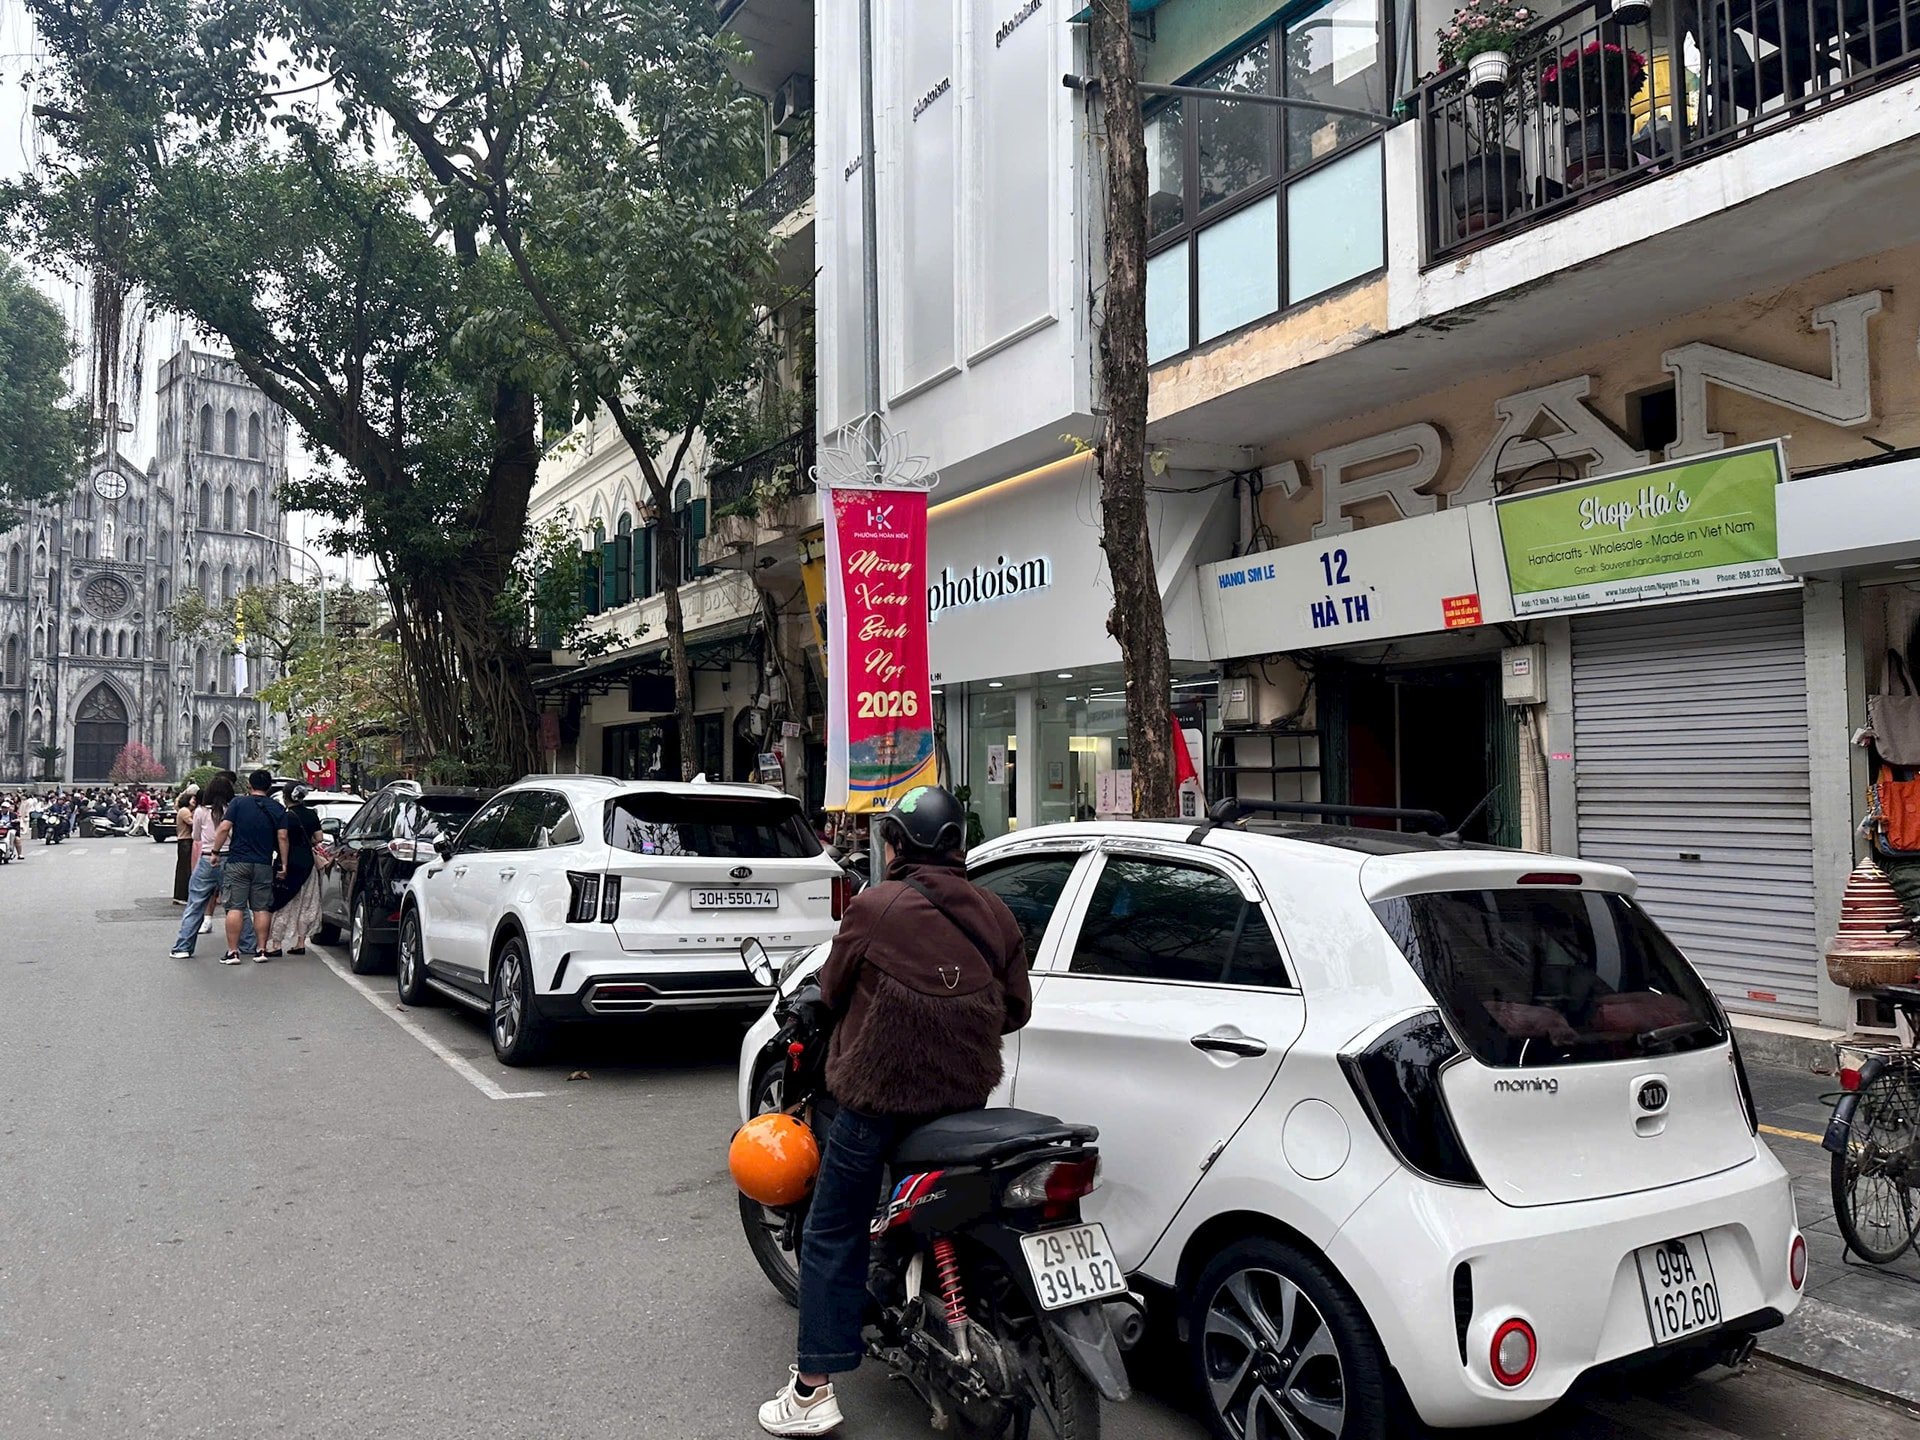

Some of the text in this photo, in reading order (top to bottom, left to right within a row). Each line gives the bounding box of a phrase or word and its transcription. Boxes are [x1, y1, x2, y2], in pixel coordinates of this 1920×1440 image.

[912, 77, 951, 122] photoism
[1579, 481, 1691, 532] Shop Ha's
[1528, 547, 1582, 567] Handicrafts
[1589, 538, 1643, 557] Wholesale
[1651, 532, 1685, 547] Made
[1687, 530, 1698, 541] in
[1699, 525, 1722, 538] Viet
[1724, 521, 1755, 535] Nam
[848, 550, 913, 580] Mừng
[1218, 570, 1245, 589] HANOI
[1320, 549, 1350, 586] 12
[1691, 577, 1700, 586] Ha
[1717, 572, 1737, 582] Phone:
[854, 582, 911, 611] Xuân
[928, 555, 1047, 623] photoism
[864, 648, 906, 683] Ngọ
[857, 690, 918, 718] 2026
[733, 868, 750, 878] KIA
[1494, 1077, 1558, 1094] morning
[1644, 1088, 1667, 1107] KIA
[1036, 1229, 1101, 1268] 29-H2
[1040, 1259, 1121, 1303] 394.82
[1656, 1248, 1695, 1288] 99A
[1654, 1283, 1718, 1337] 162.60
